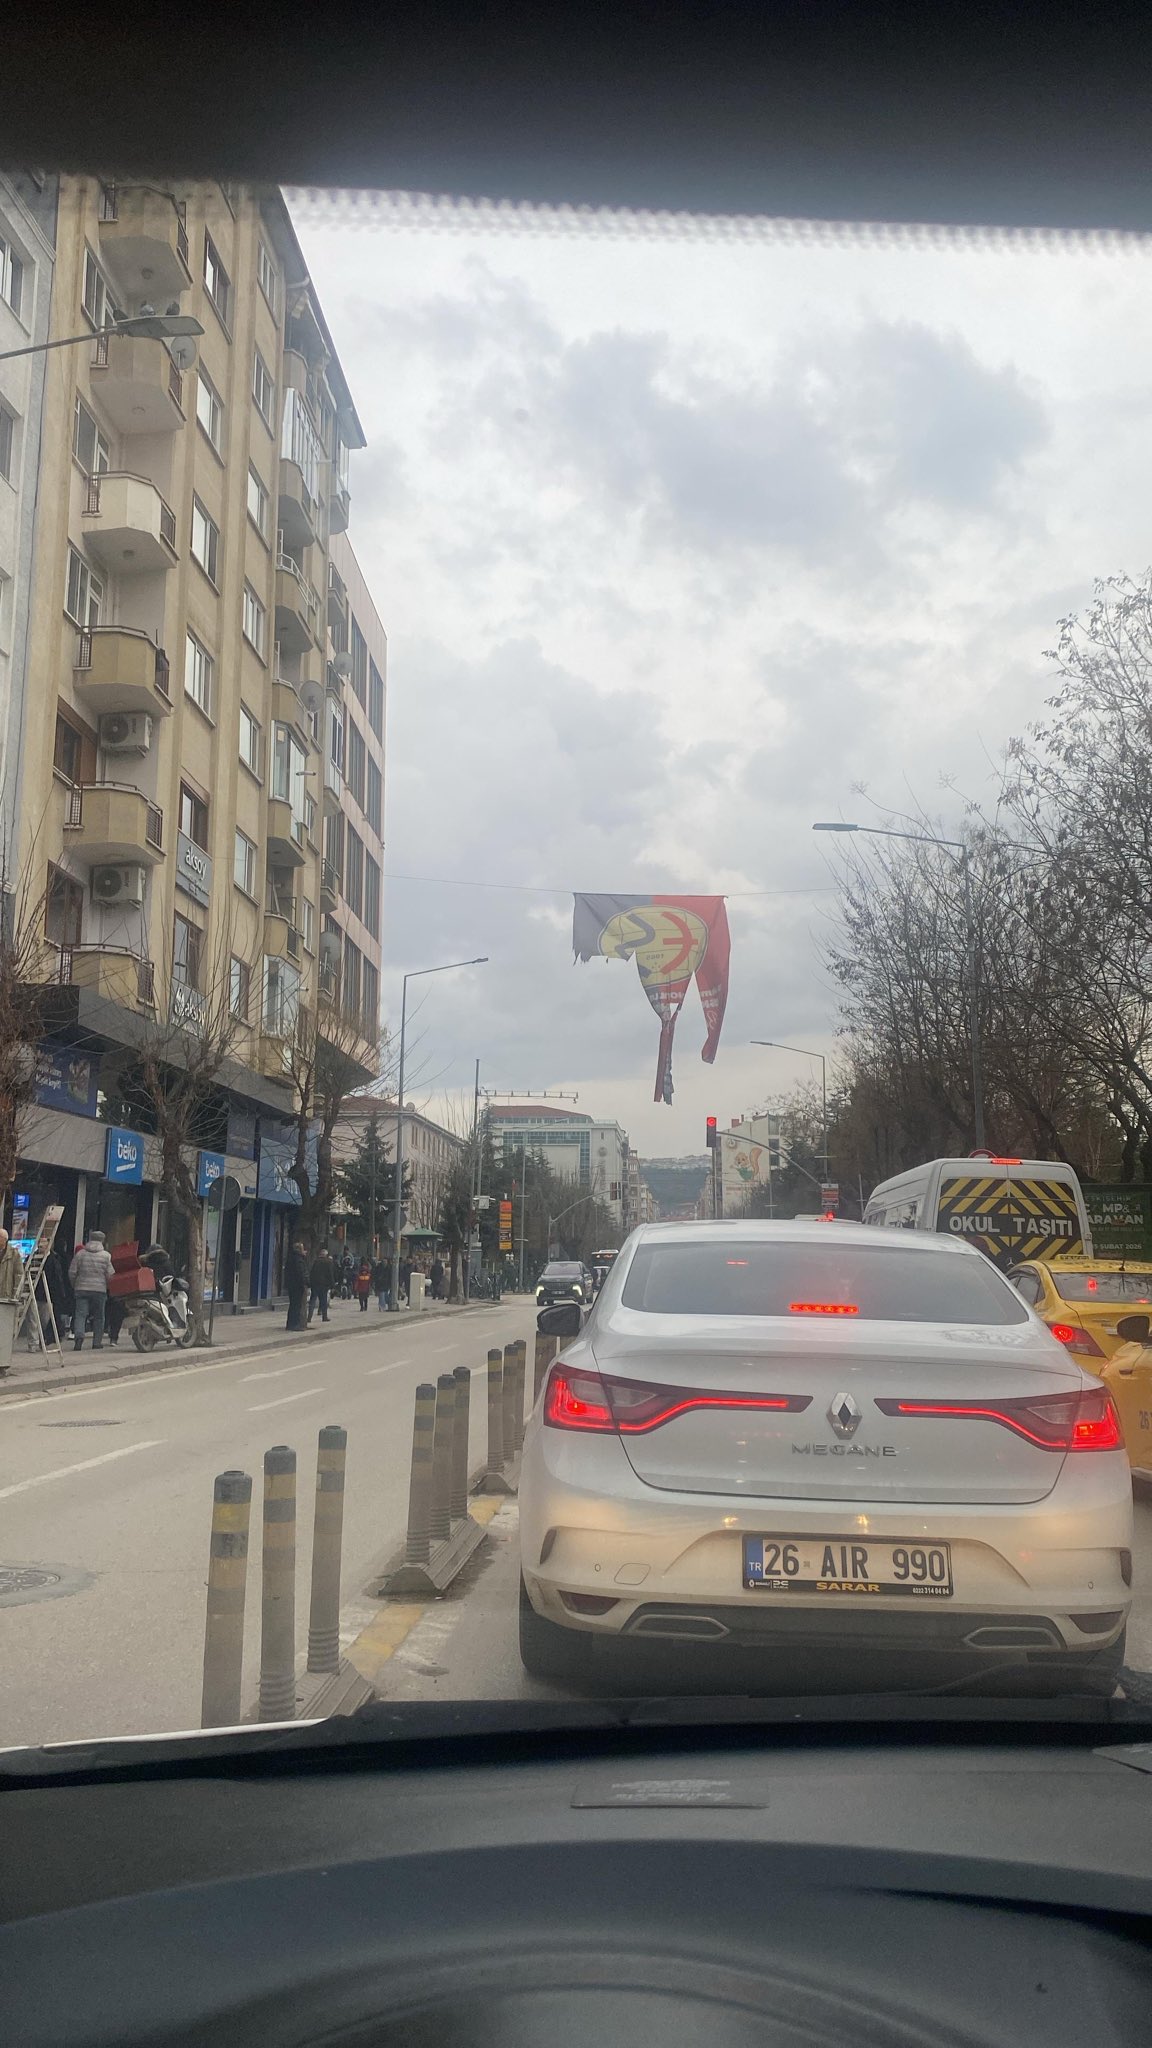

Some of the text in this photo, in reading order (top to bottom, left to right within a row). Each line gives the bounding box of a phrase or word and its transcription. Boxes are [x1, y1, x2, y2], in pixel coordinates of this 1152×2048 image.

[185, 846, 207, 881] aksoy
[117, 1138, 137, 1162] beko
[205, 1160, 220, 1179] beko
[949, 1216, 1073, 1238] OKUL TAŞITI
[791, 1442, 897, 1458] MEGANE
[749, 1562, 762, 1572] TR
[764, 1544, 946, 1582] 26 AIR 990
[816, 1582, 881, 1593] SARAR
